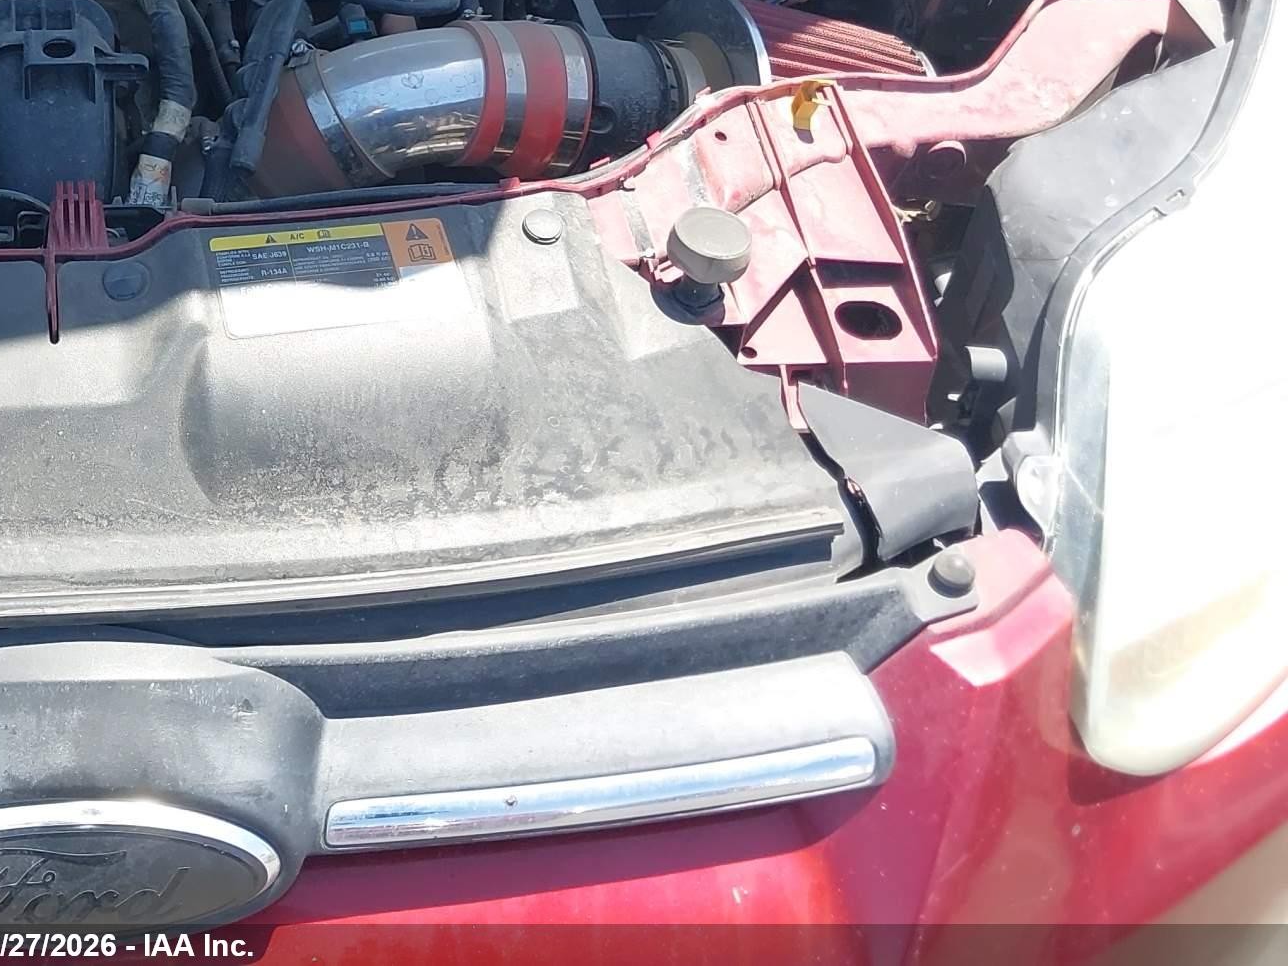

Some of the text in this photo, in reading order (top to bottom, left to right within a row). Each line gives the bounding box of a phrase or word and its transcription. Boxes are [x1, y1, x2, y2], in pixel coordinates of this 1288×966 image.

[289, 232, 305, 241] A/C
[251, 252, 268, 260] SAE
[260, 267, 288, 277] R-134A
